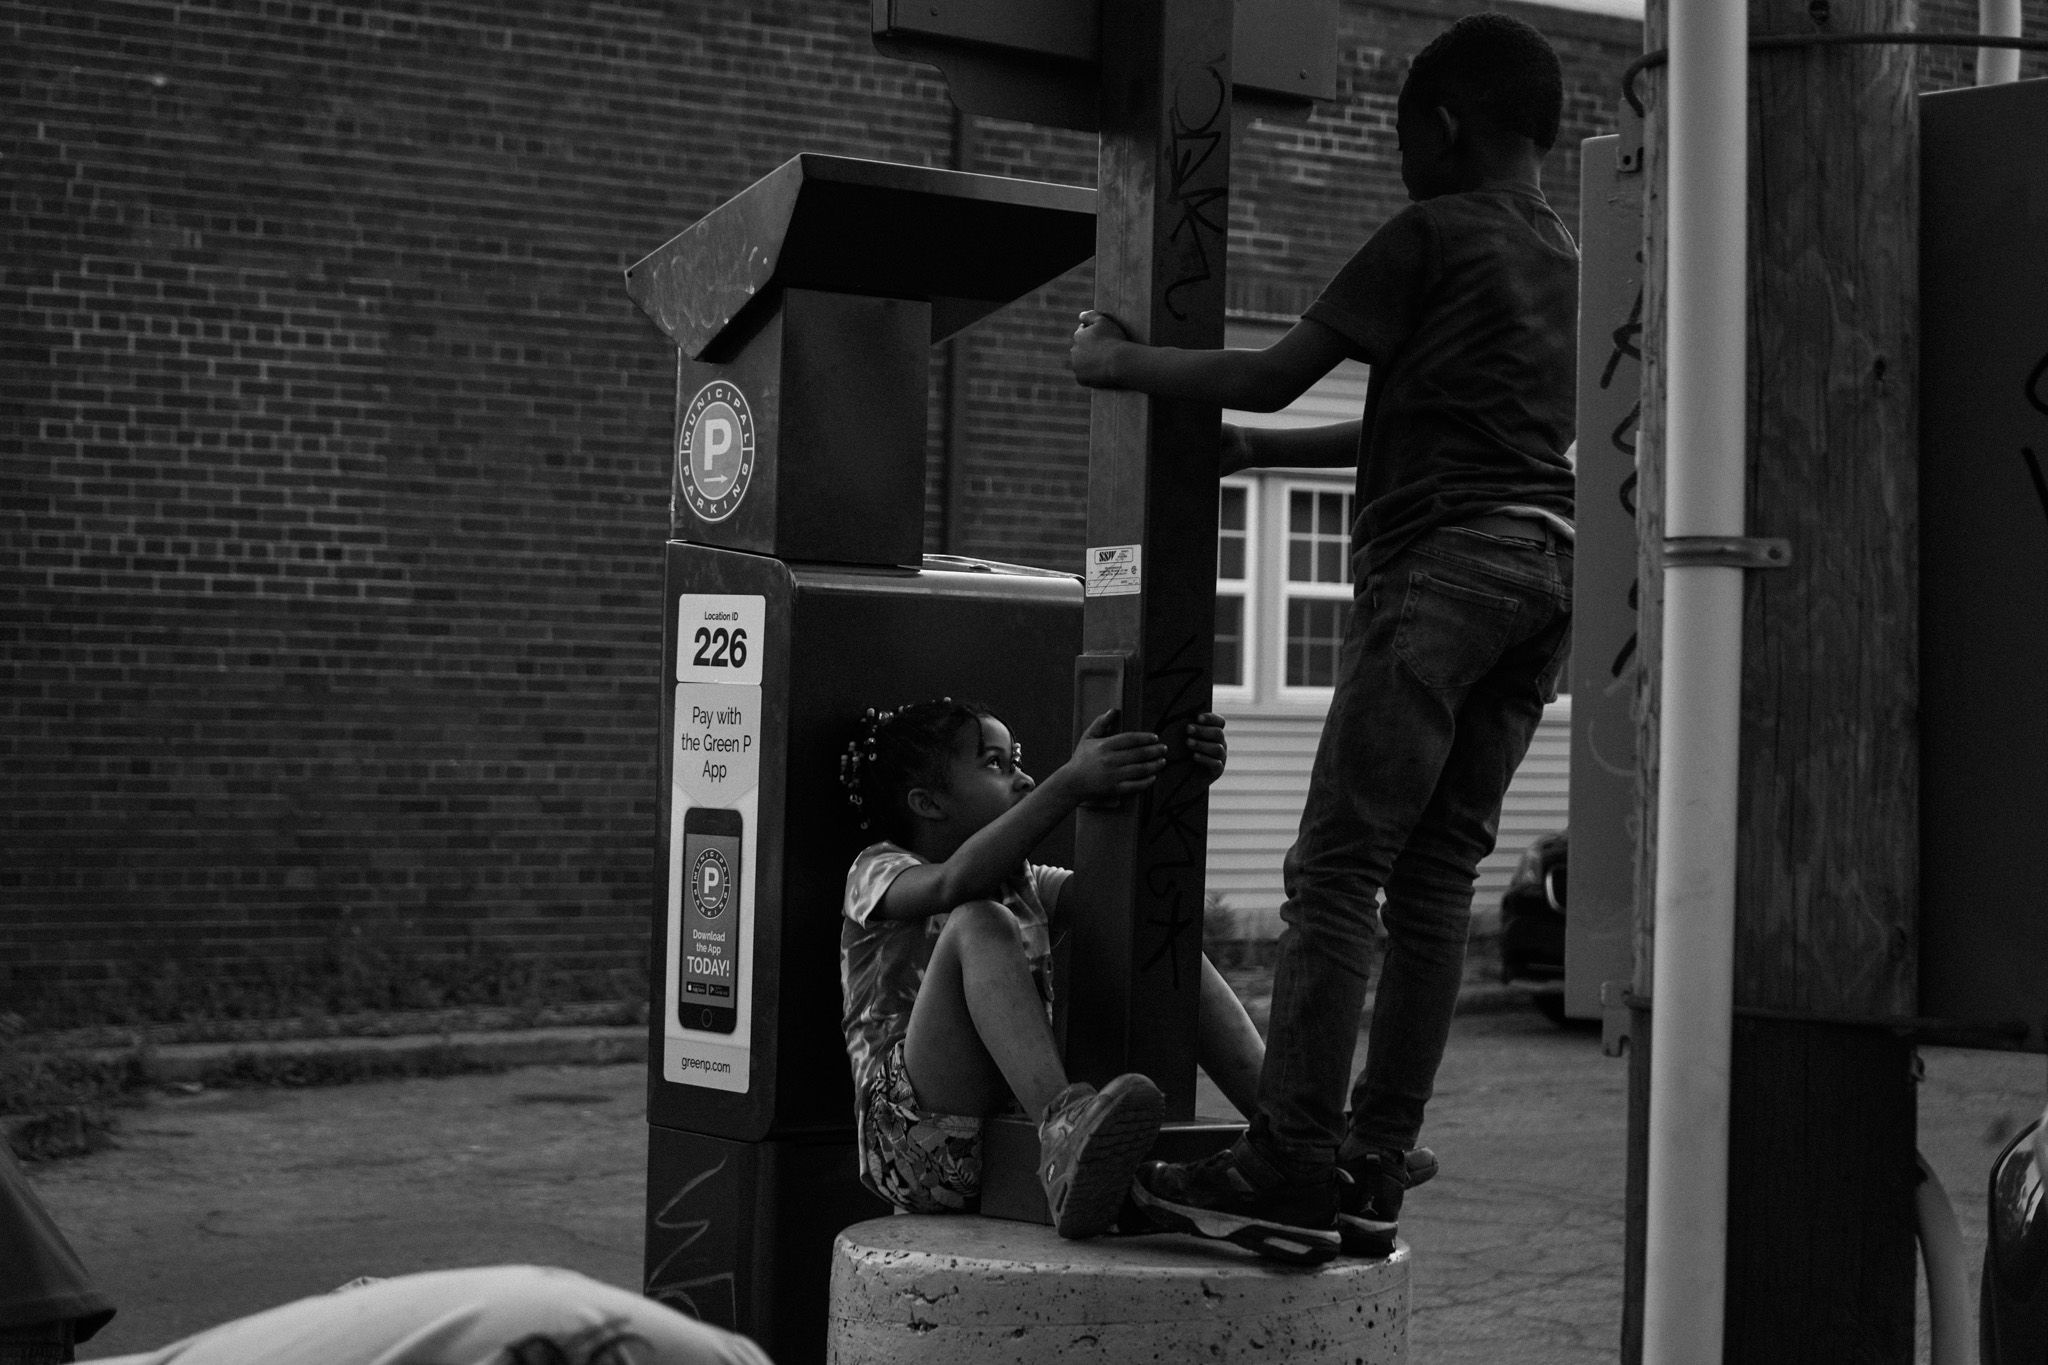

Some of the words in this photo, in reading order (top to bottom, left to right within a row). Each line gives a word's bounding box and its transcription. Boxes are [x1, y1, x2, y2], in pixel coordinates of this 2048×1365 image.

[684, 388, 750, 447] MUNICIPAL
[704, 418, 732, 470] P
[683, 462, 749, 514] PARKING
[704, 611, 731, 621] Location
[731, 611, 739, 621] ID
[693, 626, 748, 669] 226
[692, 706, 714, 729] Pay
[716, 706, 742, 725] with
[681, 732, 700, 751] the
[703, 733, 740, 752] Green
[743, 735, 752, 752] P
[702, 760, 727, 783] App
[703, 866, 720, 894] P
[692, 928, 726, 942] Download
[696, 942, 708, 953] the
[708, 943, 722, 957] App
[687, 955, 730, 977] TODAY!
[681, 1057, 731, 1074] greenp.com
